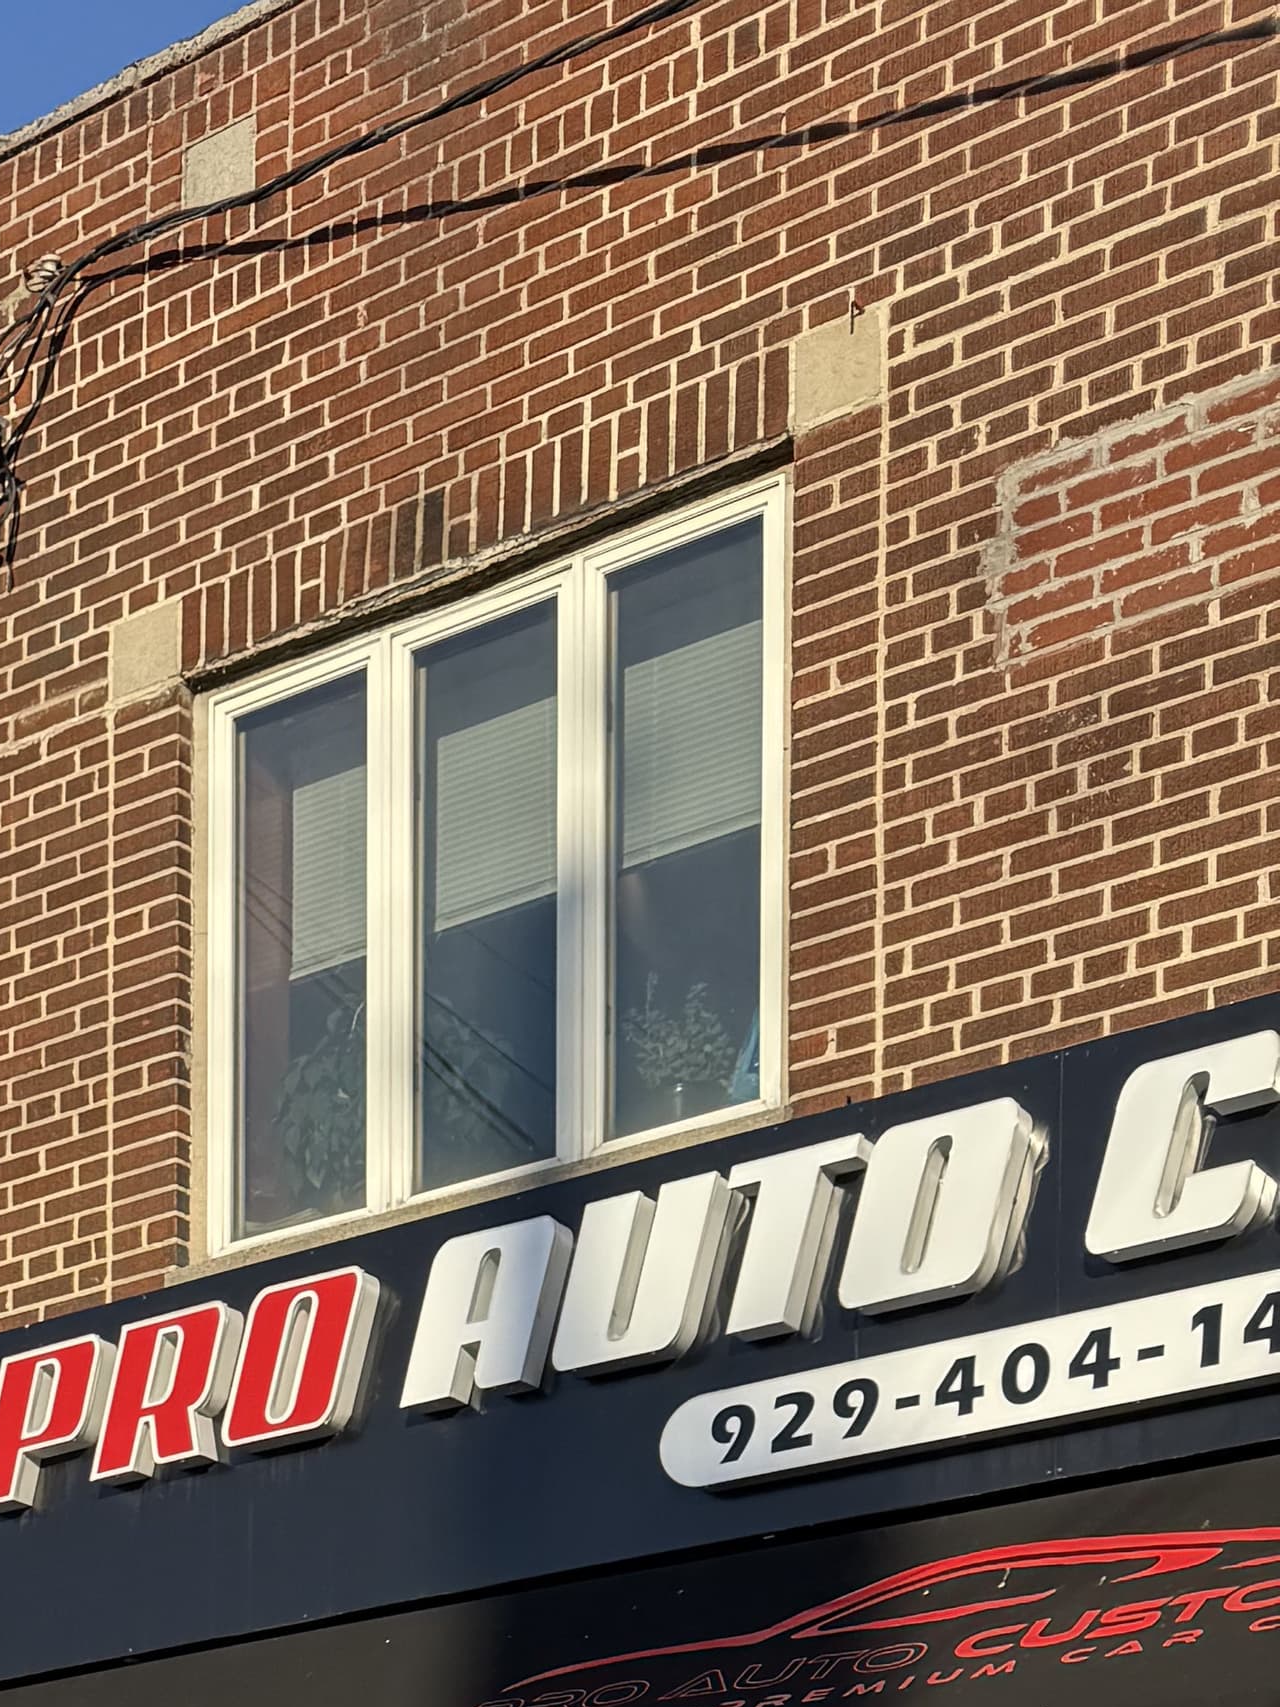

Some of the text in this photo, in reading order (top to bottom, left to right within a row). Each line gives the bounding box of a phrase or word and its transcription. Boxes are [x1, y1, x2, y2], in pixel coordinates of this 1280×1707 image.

[400, 1094, 1046, 1412] AUTO
[709, 1291, 1280, 1462] 929-404-14
[658, 1640, 928, 1702] AUTO
[1060, 1629, 1204, 1664] CAR
